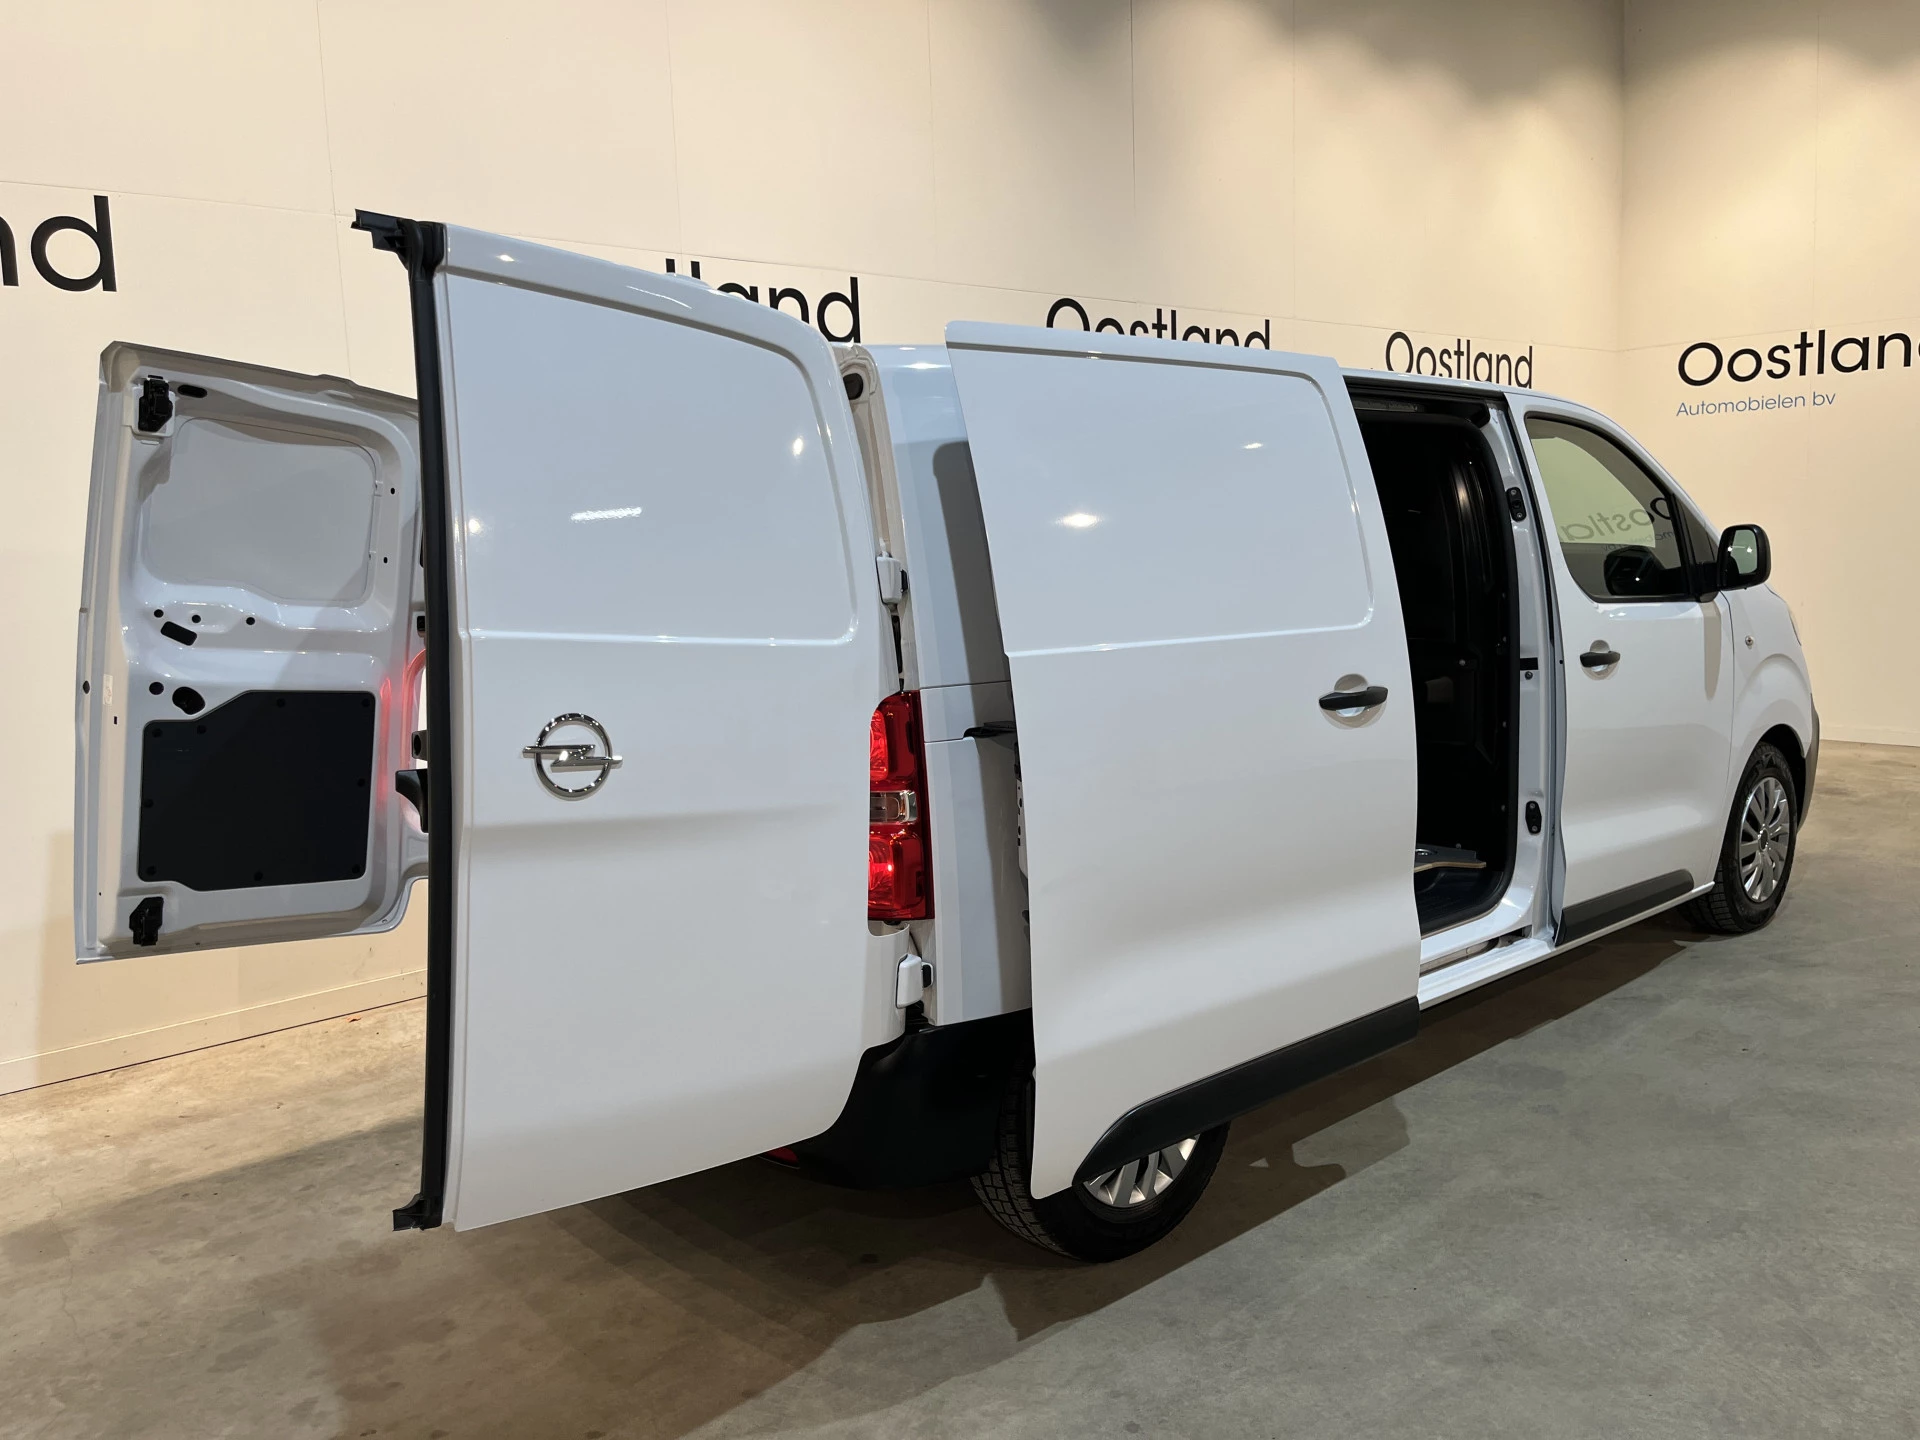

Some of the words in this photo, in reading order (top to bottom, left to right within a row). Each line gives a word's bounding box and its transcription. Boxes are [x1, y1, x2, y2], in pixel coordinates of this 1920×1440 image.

[0, 195, 117, 292] d
[1385, 331, 1533, 389] Oostland
[1678, 329, 1920, 387] Oostlan
[1676, 394, 1806, 416] Automobielen
[1812, 391, 1836, 406] bv
